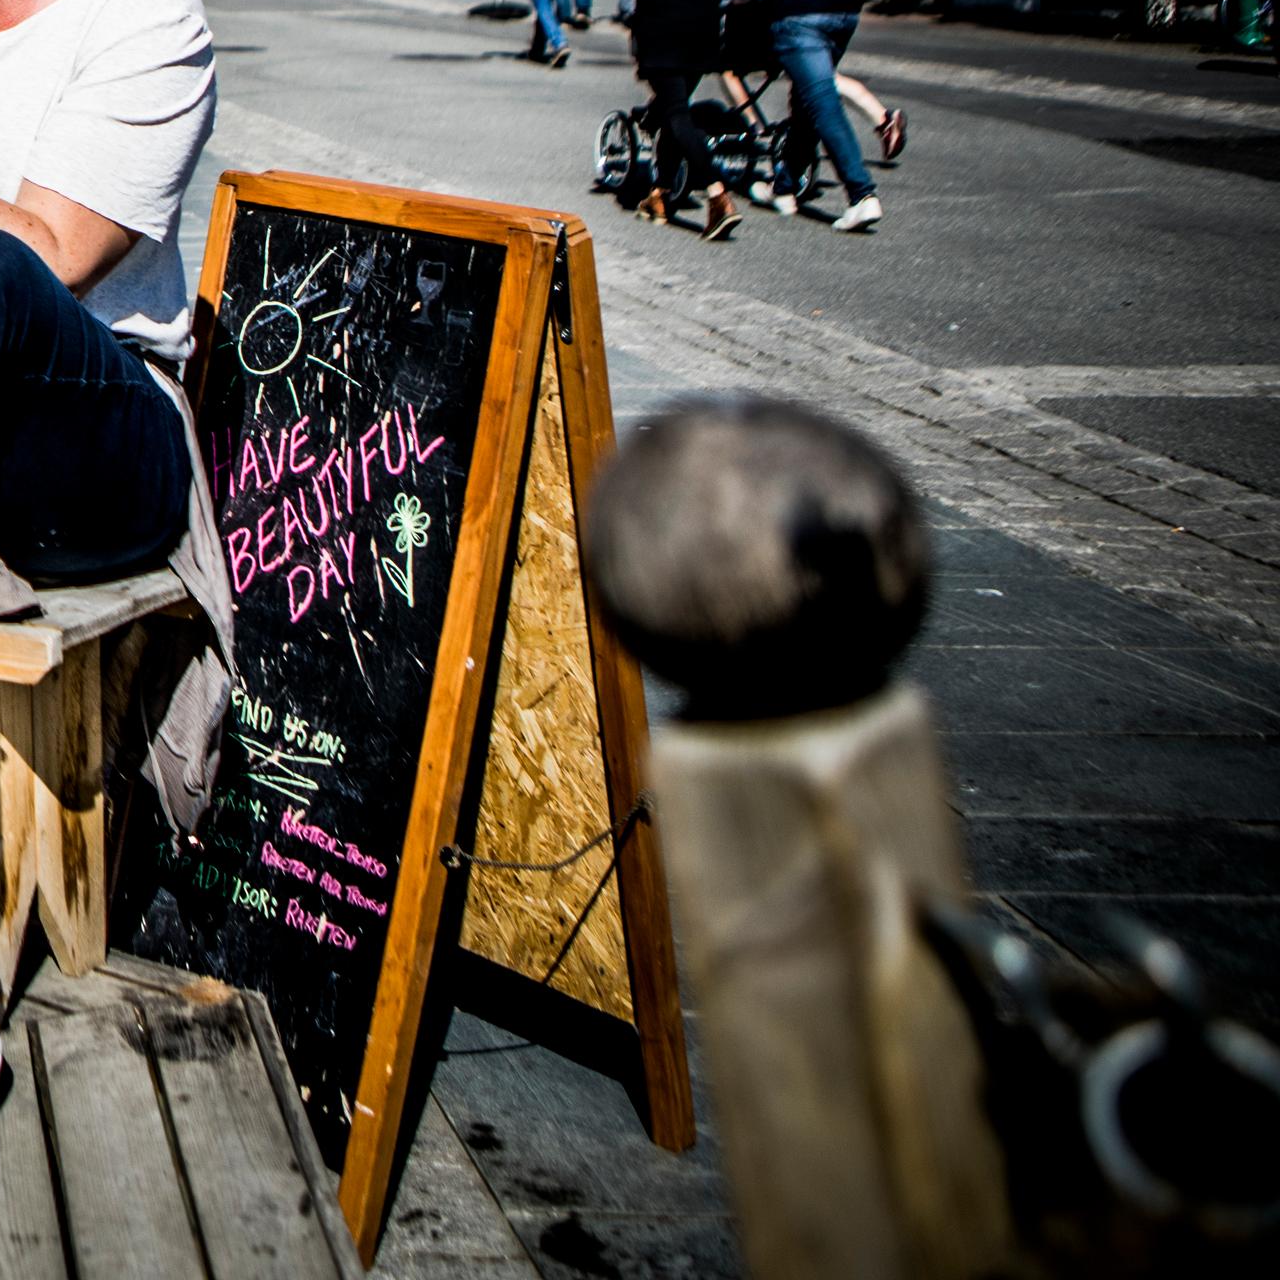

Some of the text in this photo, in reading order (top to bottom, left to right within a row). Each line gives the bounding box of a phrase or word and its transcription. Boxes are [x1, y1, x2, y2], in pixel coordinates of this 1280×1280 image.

[211, 415, 317, 500] HAVE
[227, 402, 446, 593] BEAUTYFUL
[285, 531, 356, 624] DAY
